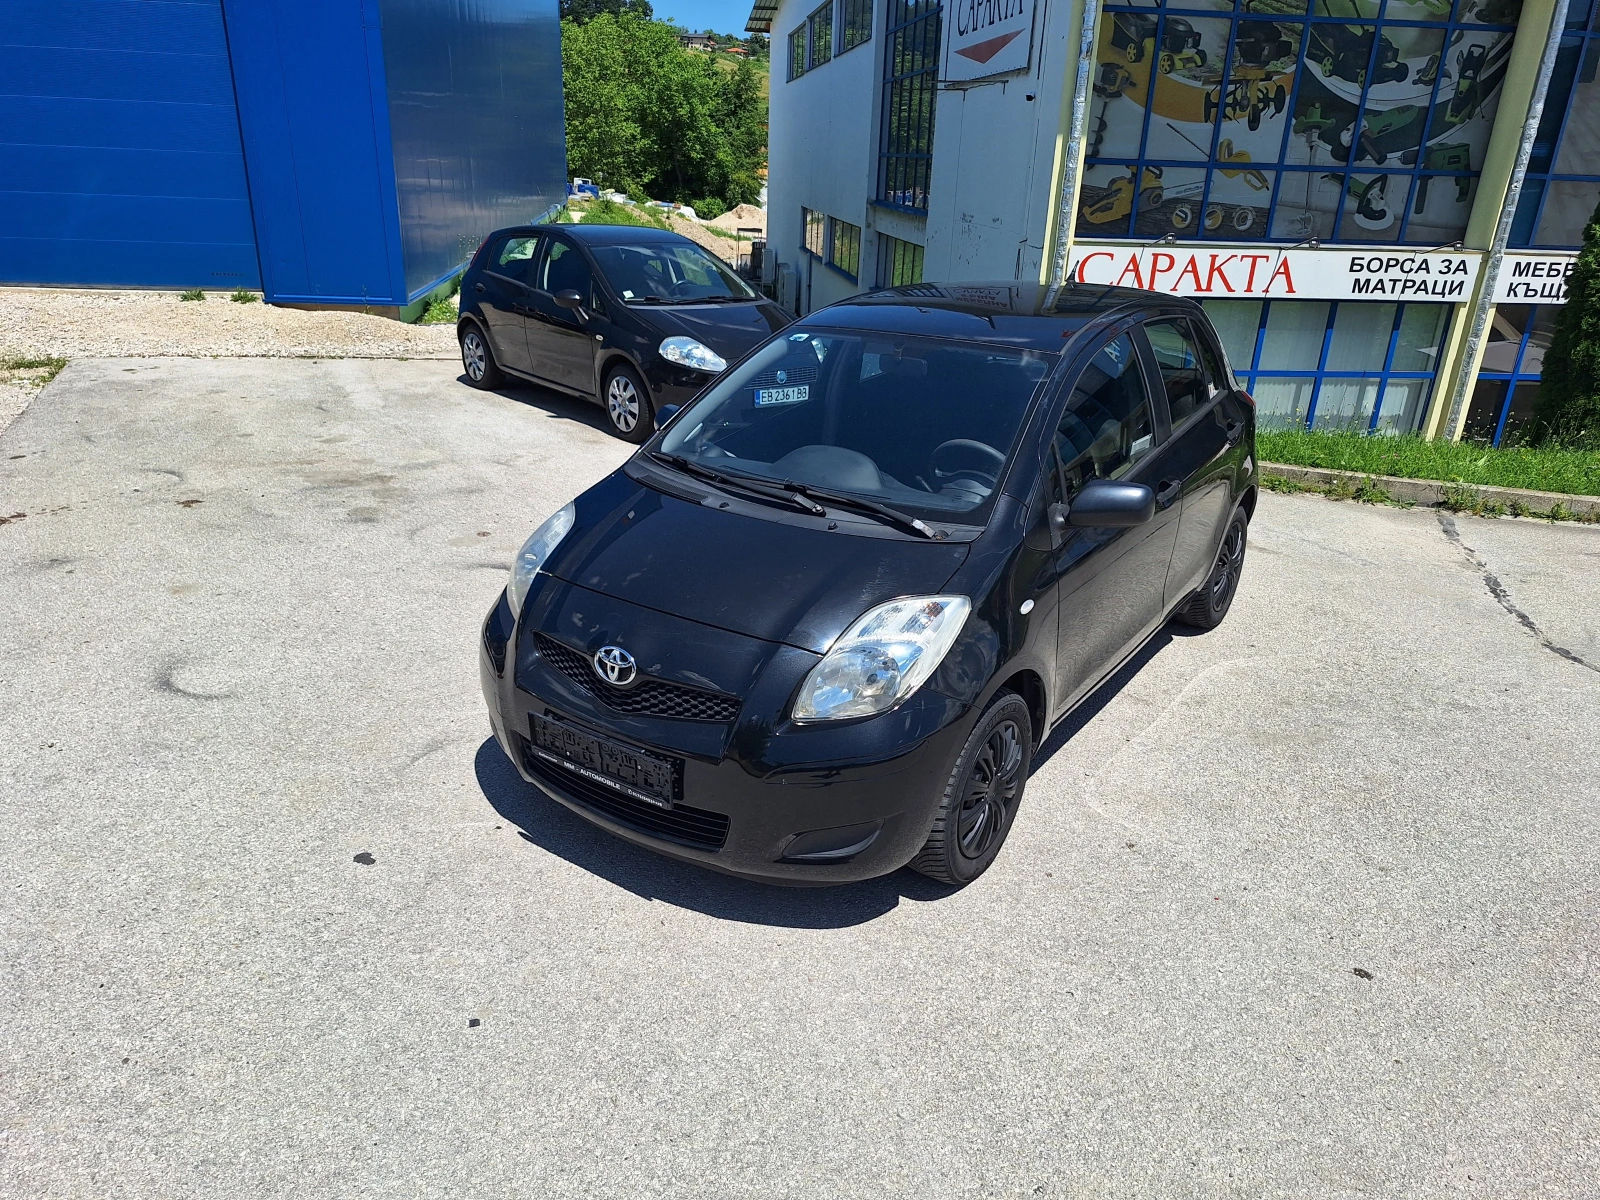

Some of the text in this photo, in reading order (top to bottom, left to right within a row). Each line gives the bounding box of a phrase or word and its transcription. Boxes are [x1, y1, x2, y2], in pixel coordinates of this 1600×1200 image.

[1077, 251, 1297, 294] САРАКТА
[1349, 256, 1469, 276] БОРСА ЗА
[1512, 261, 1578, 278] МЕБЕ
[1351, 278, 1465, 298] МАТРАЦИ
[1506, 282, 1569, 301] КЪЩ
[774, 389, 795, 402] 2361
[580, 768, 621, 790] AUTOMOBILE
